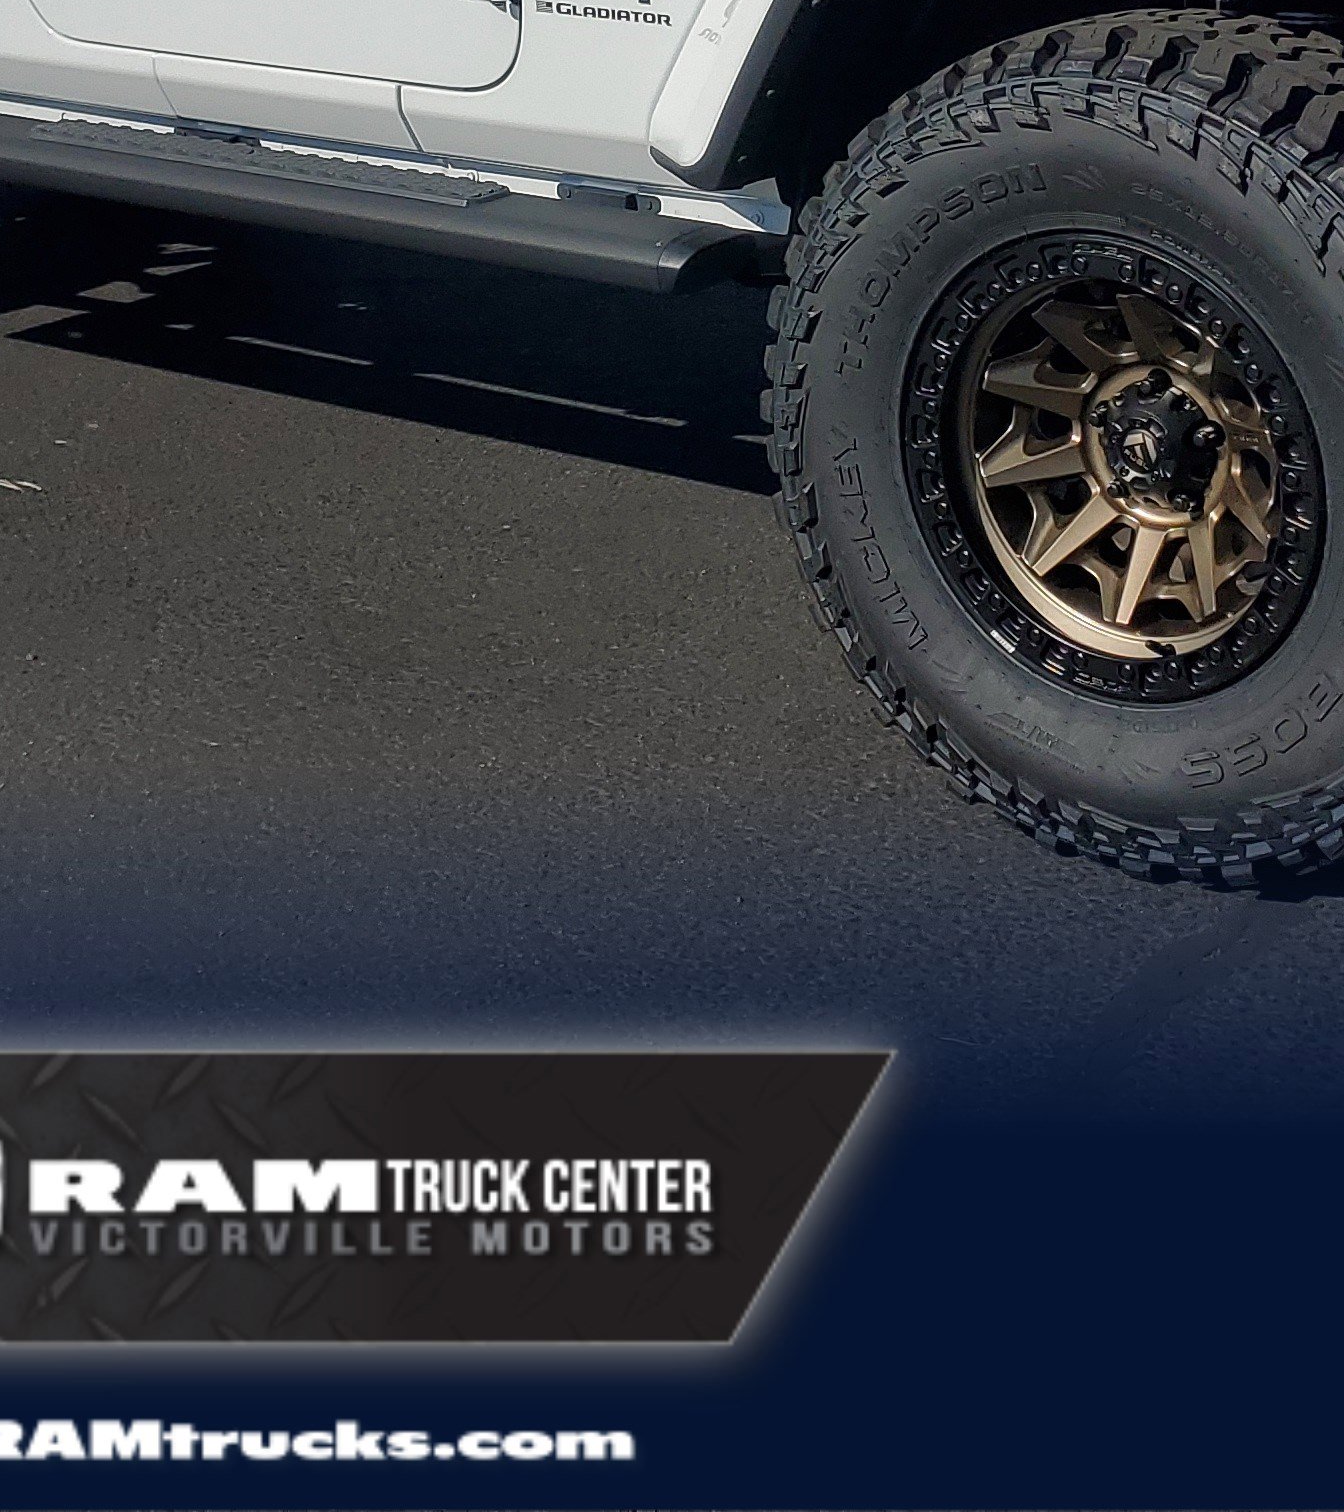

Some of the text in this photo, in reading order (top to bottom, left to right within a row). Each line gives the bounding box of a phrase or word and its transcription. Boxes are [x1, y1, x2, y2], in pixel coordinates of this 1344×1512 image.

[556, 1, 672, 27] GLADIATOR
[833, 162, 1048, 651] MICKEY THOMPSON
